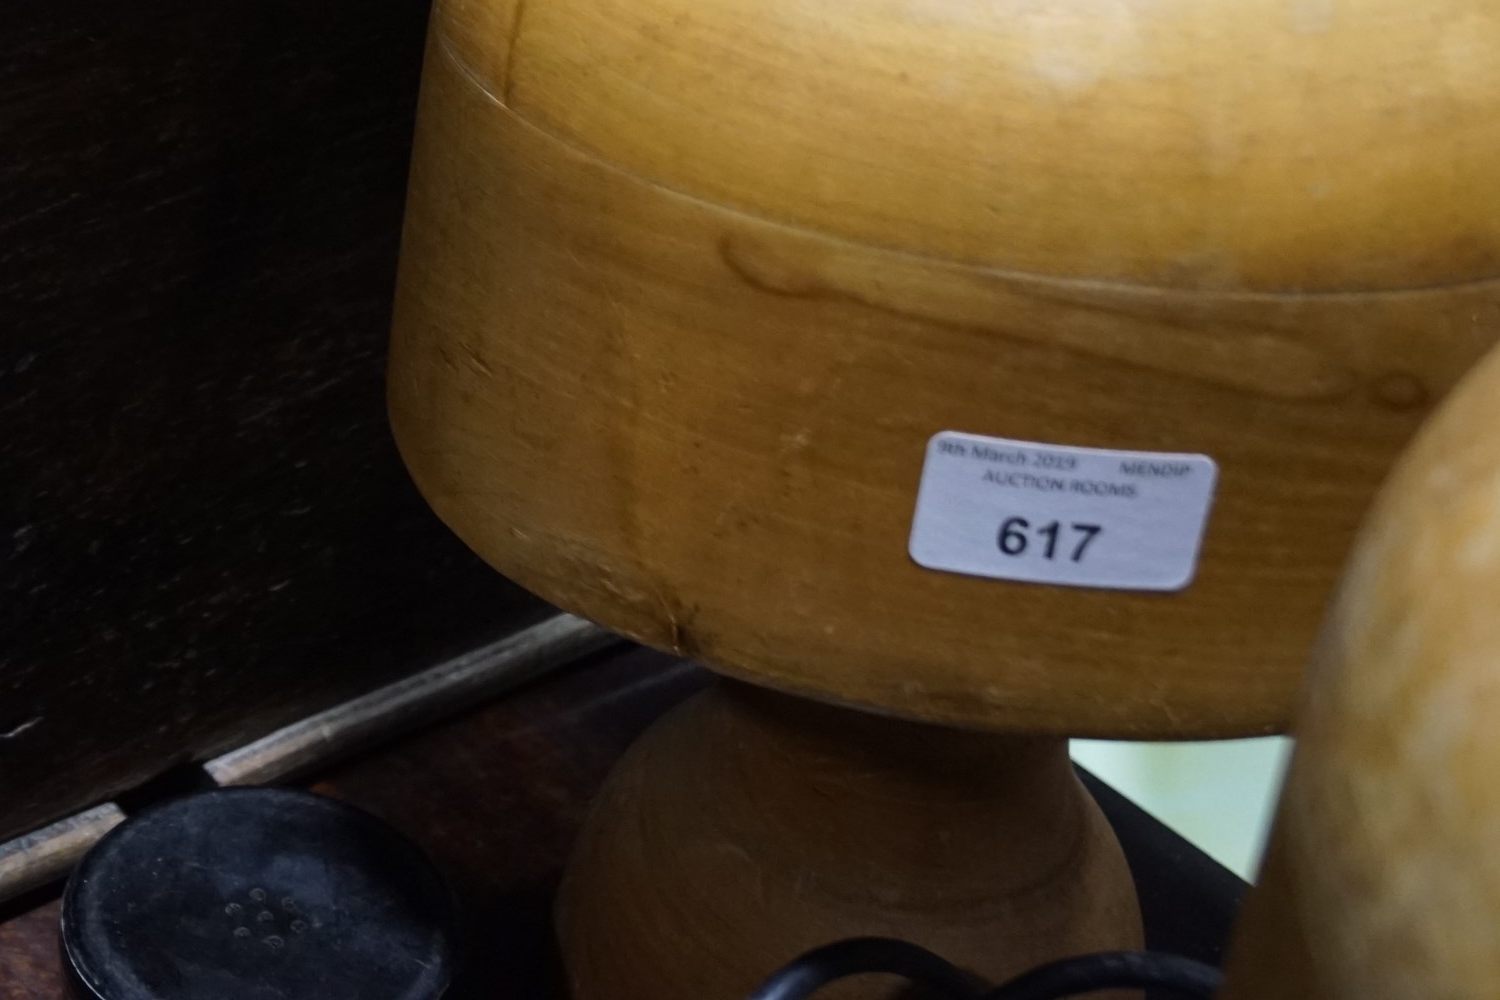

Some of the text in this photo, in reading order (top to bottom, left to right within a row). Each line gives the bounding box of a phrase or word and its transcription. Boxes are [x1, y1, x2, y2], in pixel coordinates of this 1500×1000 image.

[972, 445, 1027, 466] March
[1033, 452, 1079, 470] 2019
[1119, 460, 1193, 478] MENDIP
[982, 468, 1138, 498] AUCTION ROOMS
[997, 515, 1103, 562] 617
